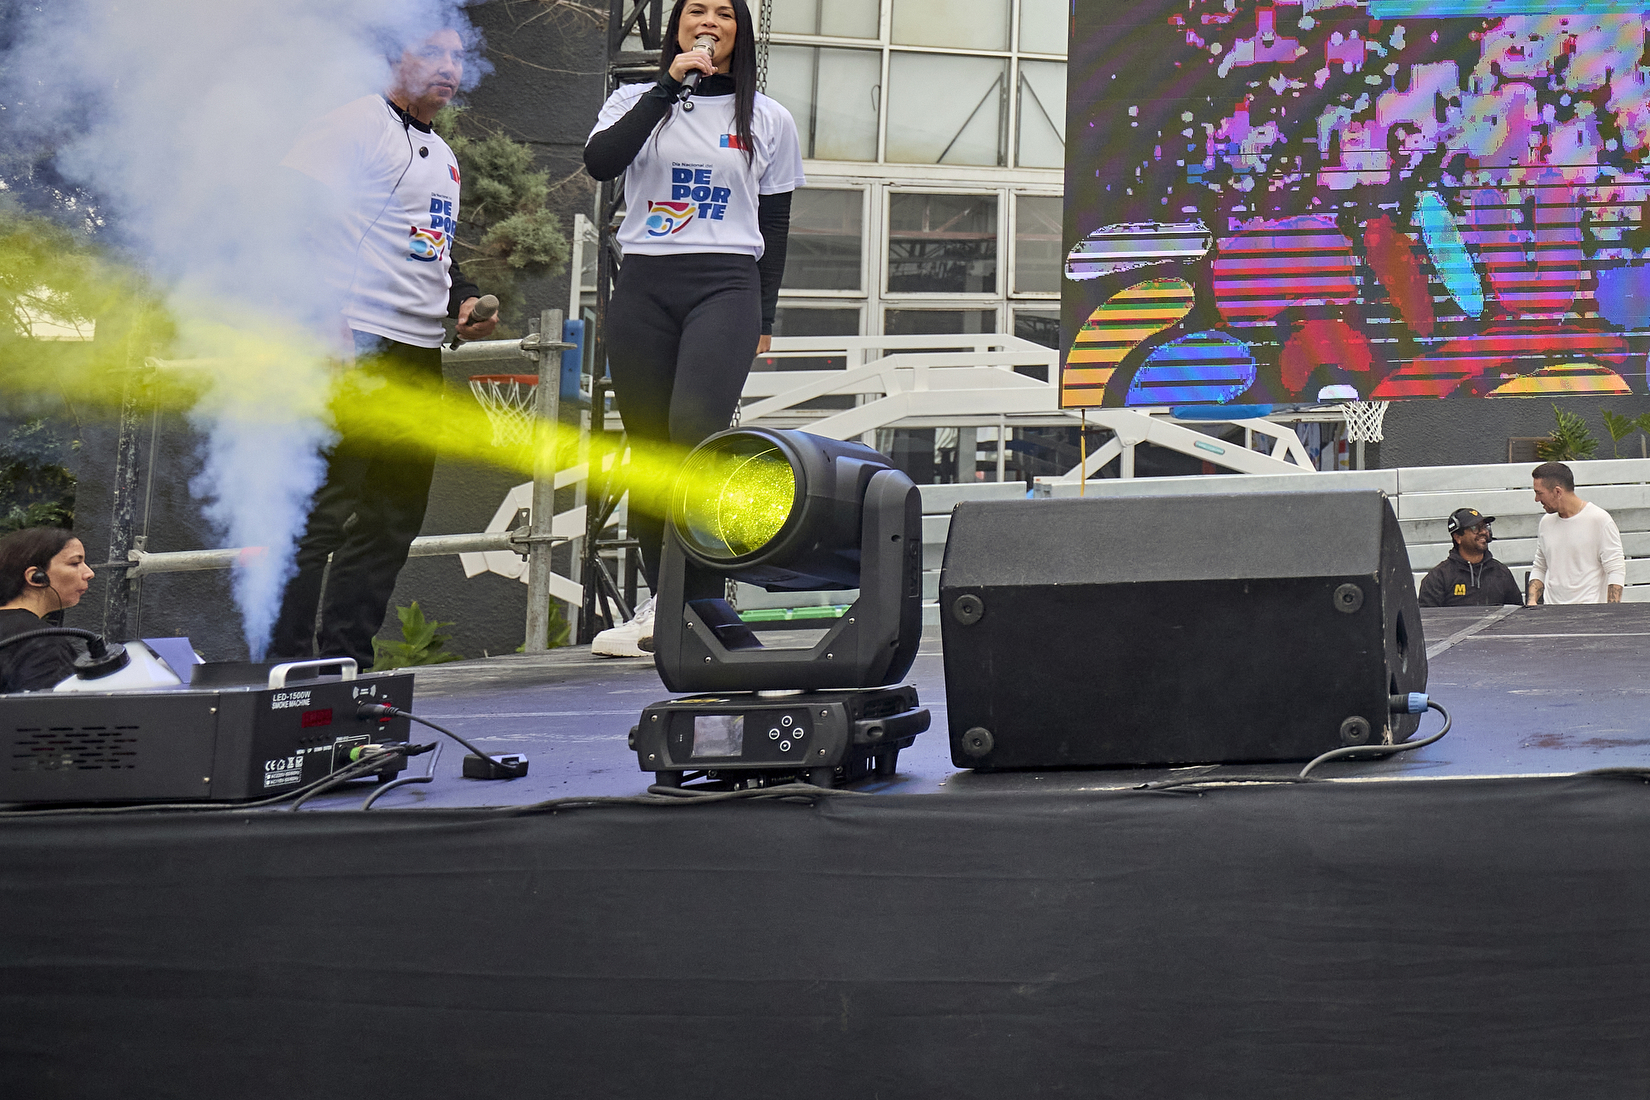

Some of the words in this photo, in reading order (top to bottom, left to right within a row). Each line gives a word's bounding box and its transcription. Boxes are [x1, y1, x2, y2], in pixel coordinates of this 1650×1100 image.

[672, 167, 712, 185] DE
[671, 184, 731, 204] POR
[429, 197, 452, 216] DE
[697, 202, 727, 220] TE
[271, 700, 289, 710] SMOKE
[288, 698, 311, 707] MACHINE
[272, 690, 311, 702] LED-1500W
